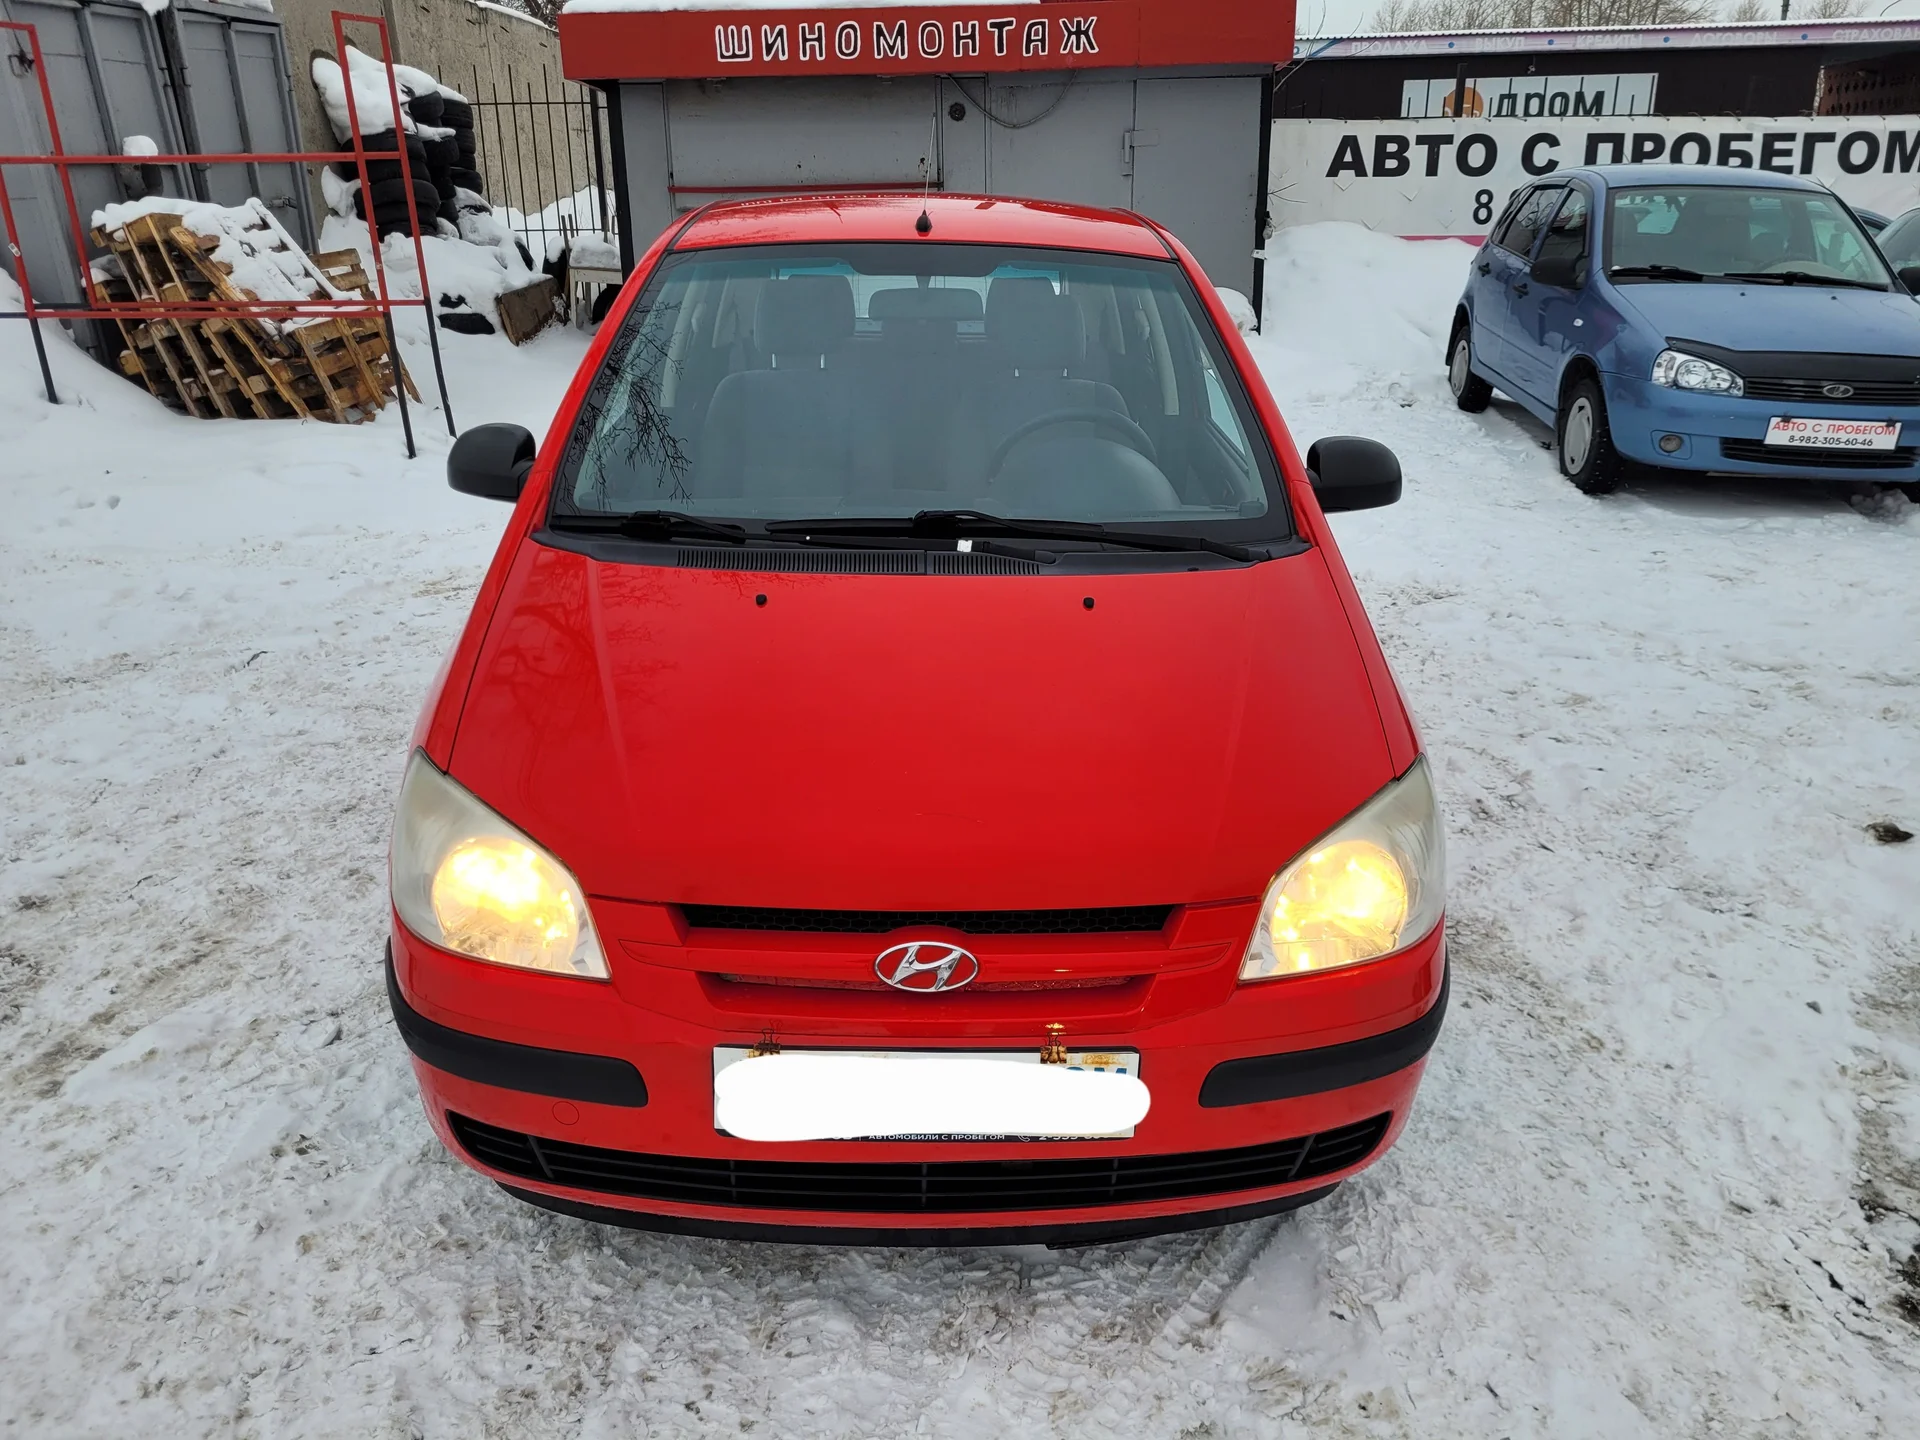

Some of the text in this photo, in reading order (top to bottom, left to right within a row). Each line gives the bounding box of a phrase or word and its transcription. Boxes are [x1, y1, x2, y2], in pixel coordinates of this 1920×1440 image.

[714, 15, 1100, 63] ШИНОМОНТАЖ
[1351, 40, 1429, 54] ПРОДАЖА
[1475, 36, 1527, 50] ВЫКУП
[1575, 33, 1643, 47] КРЕДИТЫ
[1691, 31, 1778, 44] ДОГОВОРЫ
[1325, 130, 1920, 178] АВТО С ПРОБЕГОМ
[1472, 189, 1494, 225] 8
[1772, 420, 1897, 436] АВТО С ПРОБЕГОМ
[1788, 434, 1874, 447] 8-982-305-60-46
[868, 1133, 939, 1141] АВТОМОБИЛИ
[951, 1133, 1005, 1141] ПРОБЕГОМ
